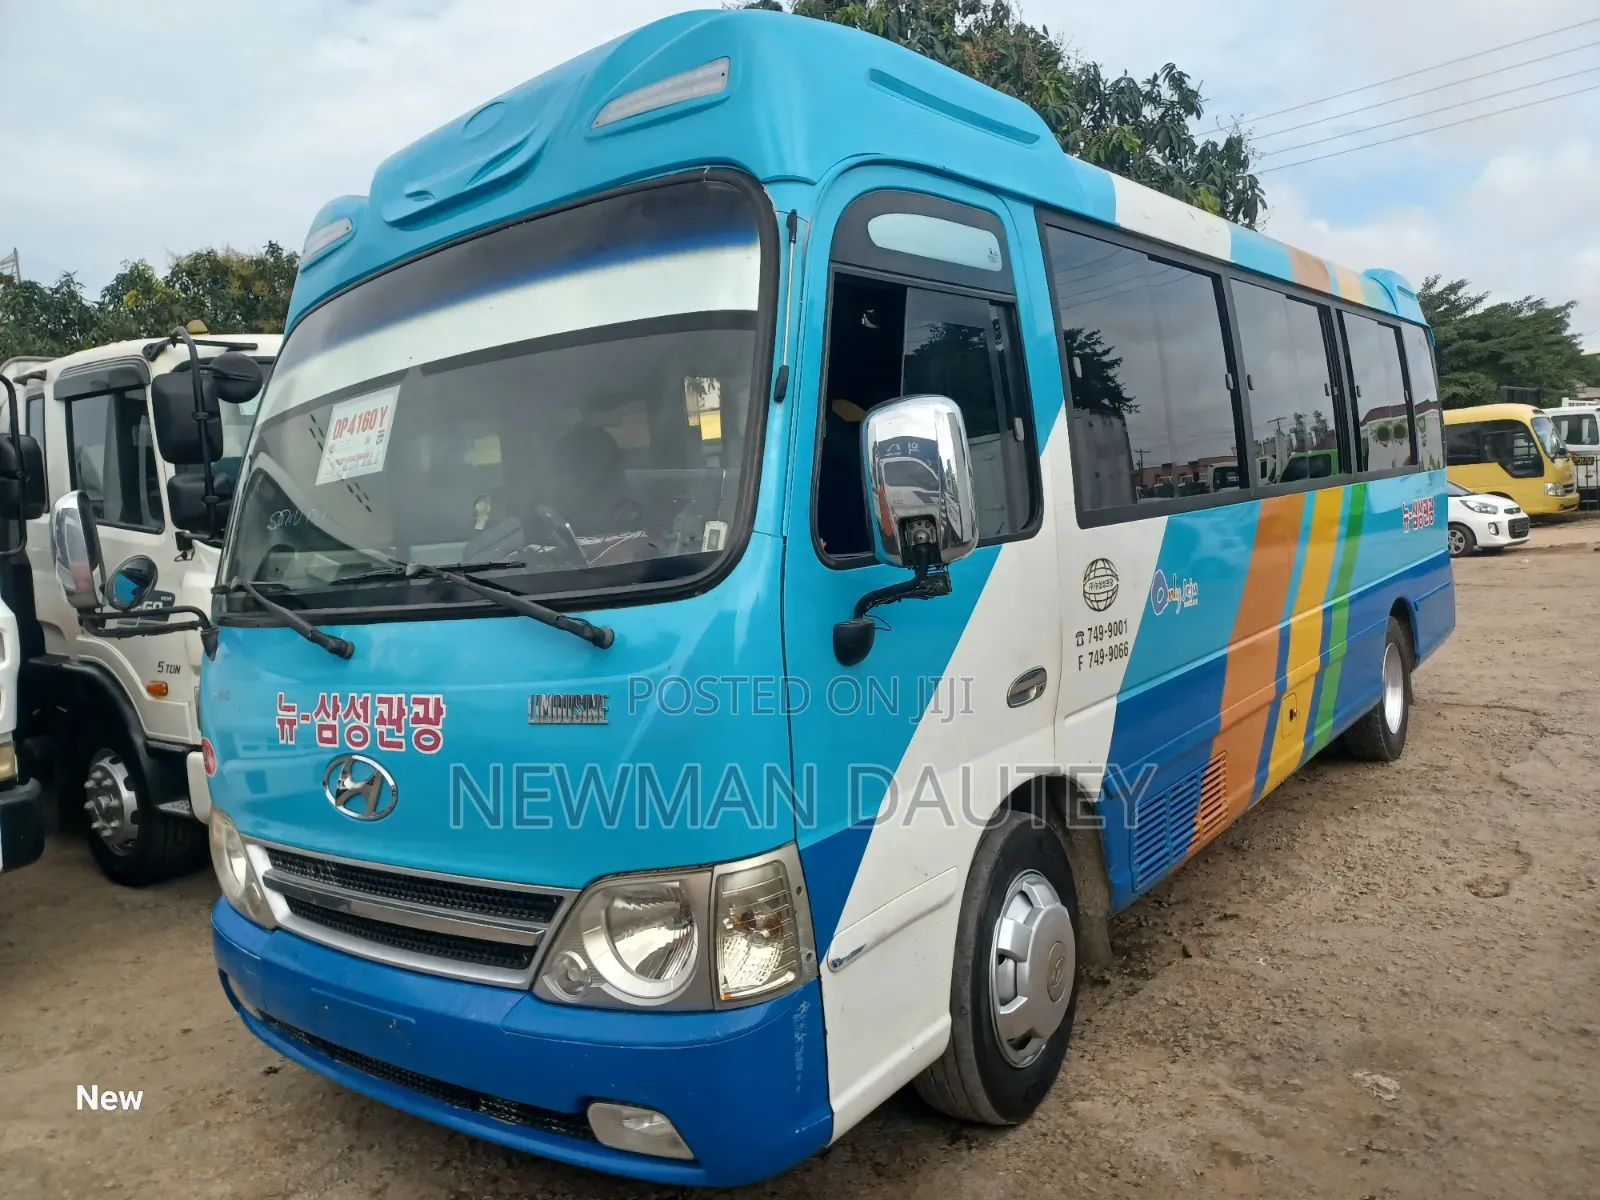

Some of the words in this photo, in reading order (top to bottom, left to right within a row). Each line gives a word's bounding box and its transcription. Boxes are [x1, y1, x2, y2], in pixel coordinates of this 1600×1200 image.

[1088, 619, 1128, 644] 749-9001
[157, 661, 165, 673] 5
[166, 664, 181, 674] TON
[1078, 655, 1084, 671] F
[1089, 642, 1128, 668] 749-9066
[275, 692, 447, 755] 뉴-삼성관광
[528, 693, 609, 725] LIMOUSINE
